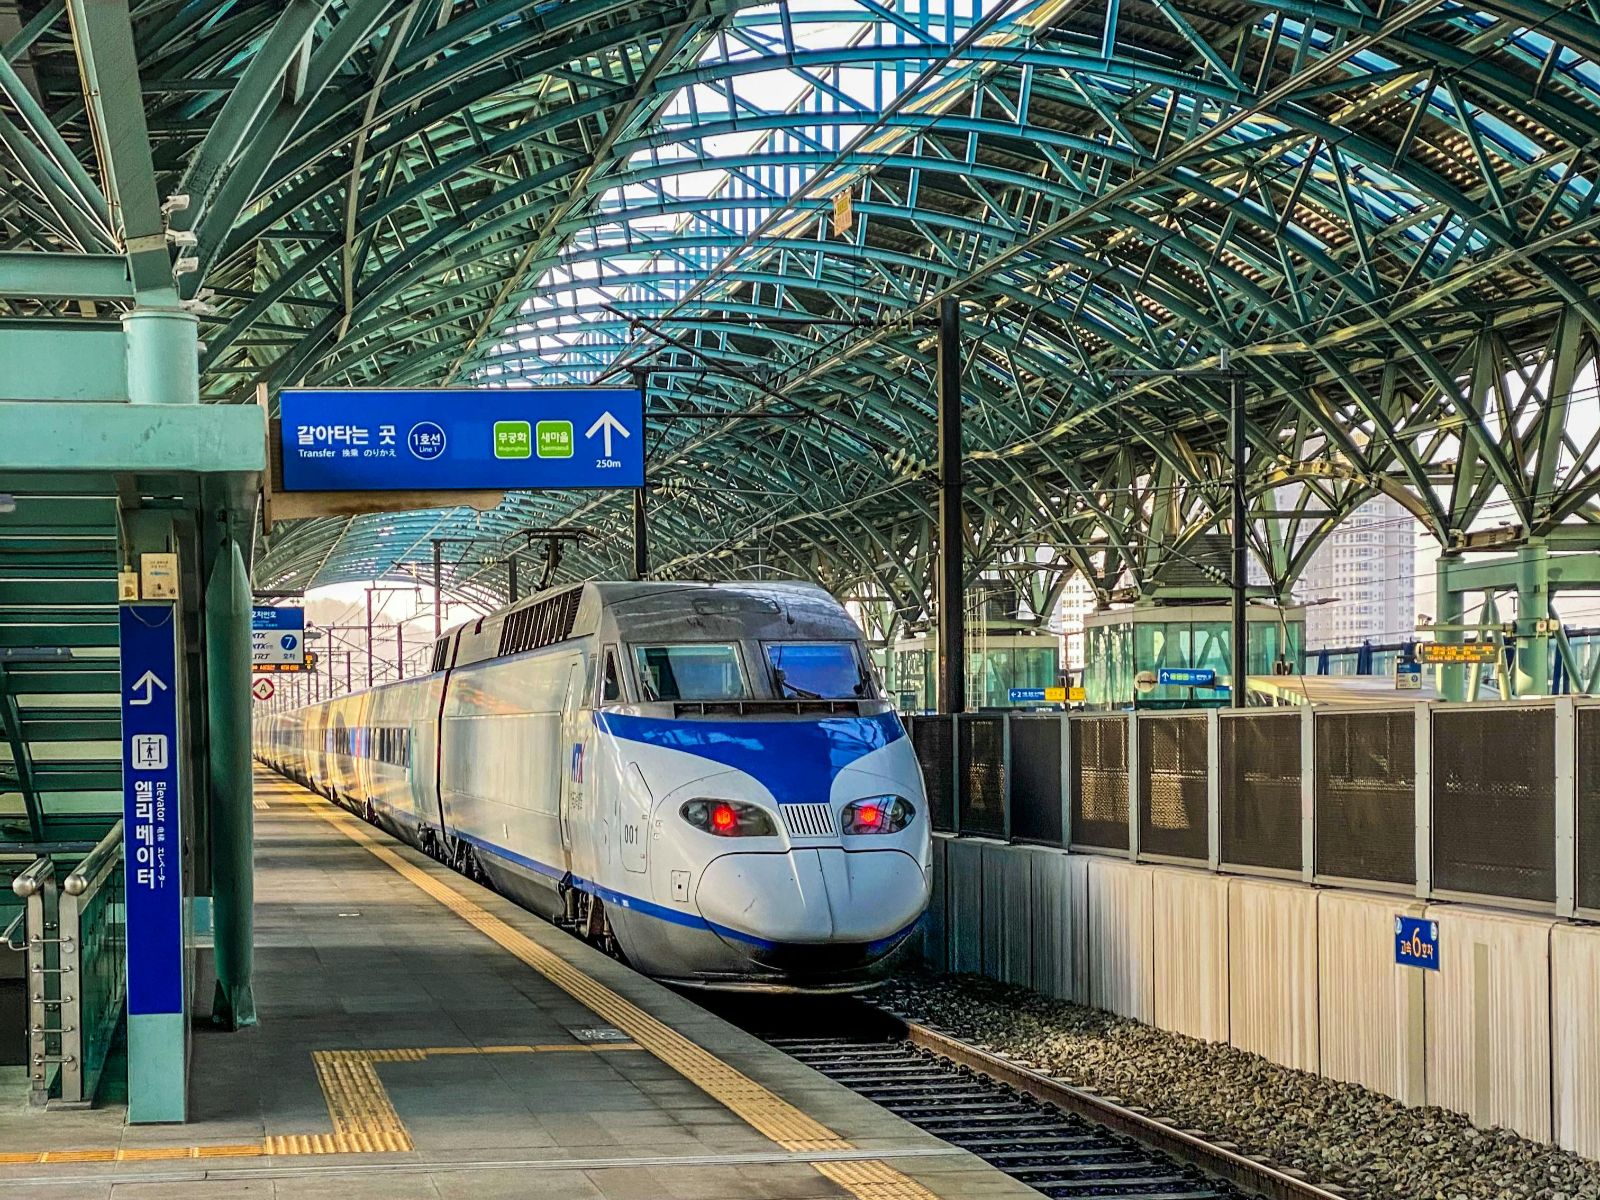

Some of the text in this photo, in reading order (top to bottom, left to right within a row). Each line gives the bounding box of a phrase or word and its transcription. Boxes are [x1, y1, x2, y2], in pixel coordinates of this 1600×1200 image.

[297, 425, 396, 445] 갈아타는 곳
[413, 433, 441, 446] 1호선
[498, 431, 527, 443] 무궁화
[541, 431, 569, 443] 새마을
[299, 448, 336, 458] Transfer
[363, 449, 397, 457] のりかえ
[596, 460, 621, 468] 250m
[285, 636, 293, 649] 7
[260, 684, 266, 692] A
[156, 781, 167, 822] Elevator
[135, 781, 154, 890] 엘리베이터
[624, 824, 639, 845] 001
[157, 847, 166, 889] エレベーター
